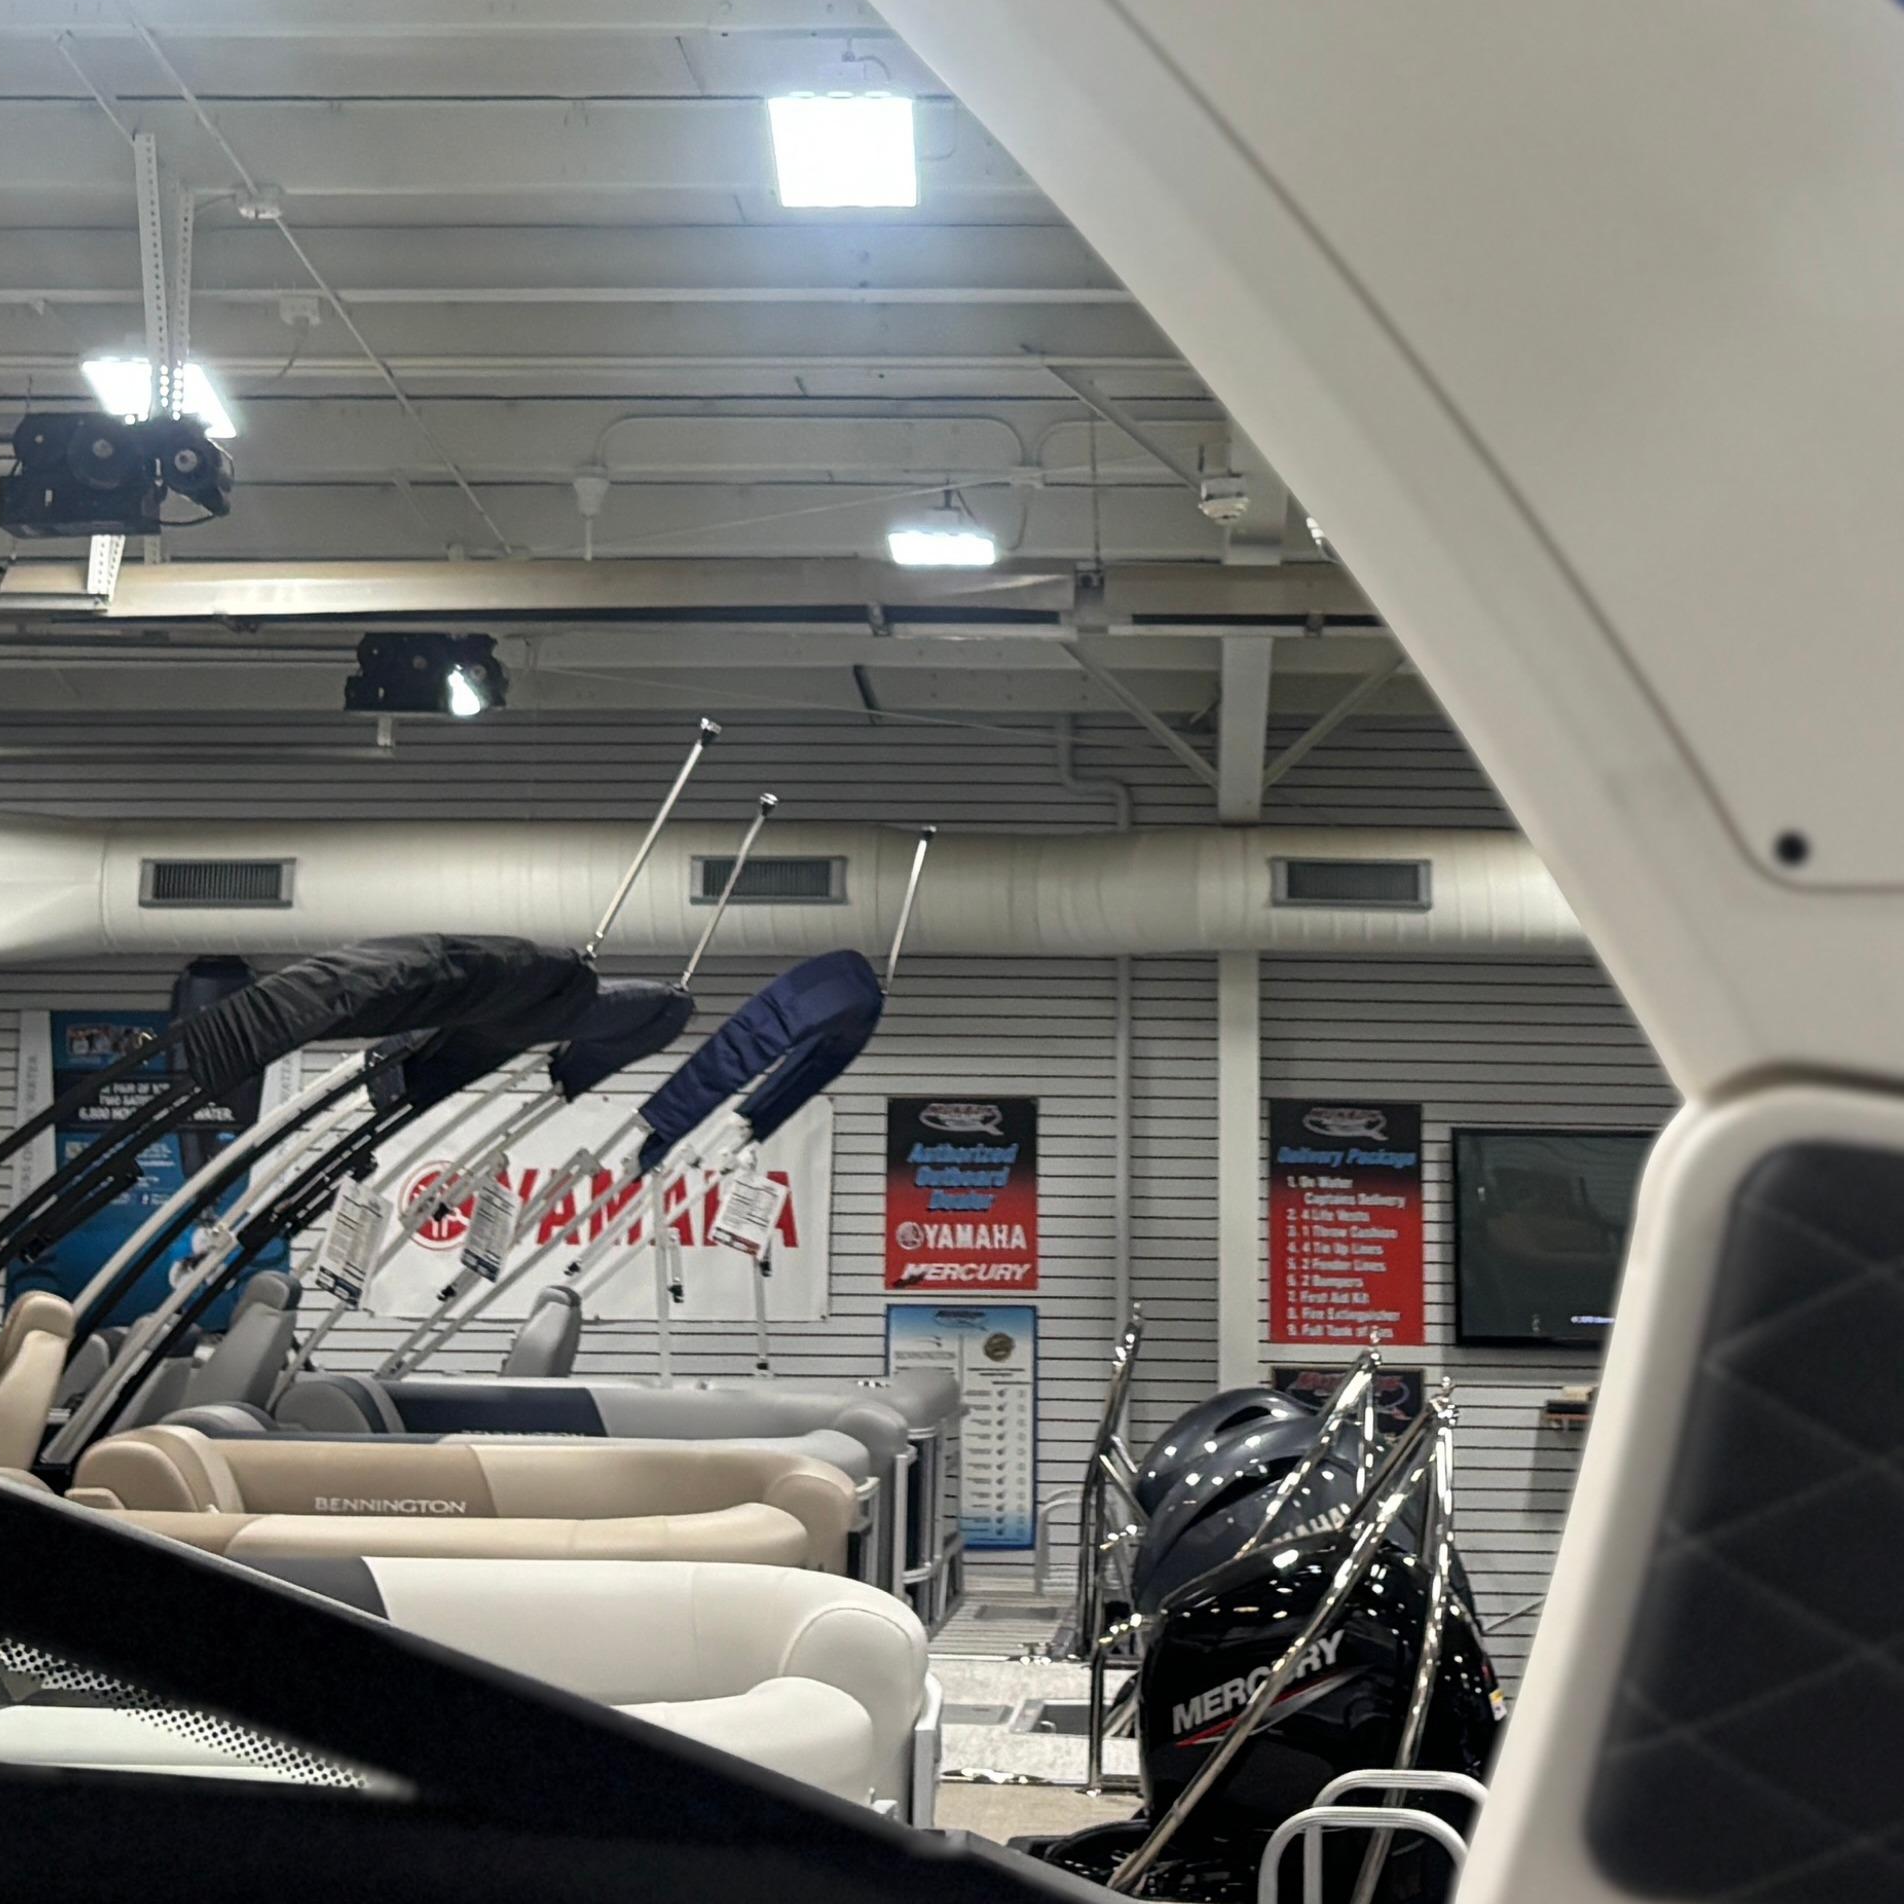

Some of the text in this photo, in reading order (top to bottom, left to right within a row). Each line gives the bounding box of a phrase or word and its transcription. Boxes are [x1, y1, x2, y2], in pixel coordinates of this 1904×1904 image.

[907, 1142, 1019, 1164] Authorized
[914, 1165, 1011, 1188] Outboard
[923, 1223, 1027, 1251] YAMAHA
[900, 1262, 1032, 1282] MERCURY
[314, 1496, 467, 1514] BENNINGTON
[1172, 1629, 1345, 1735] MERCRY
